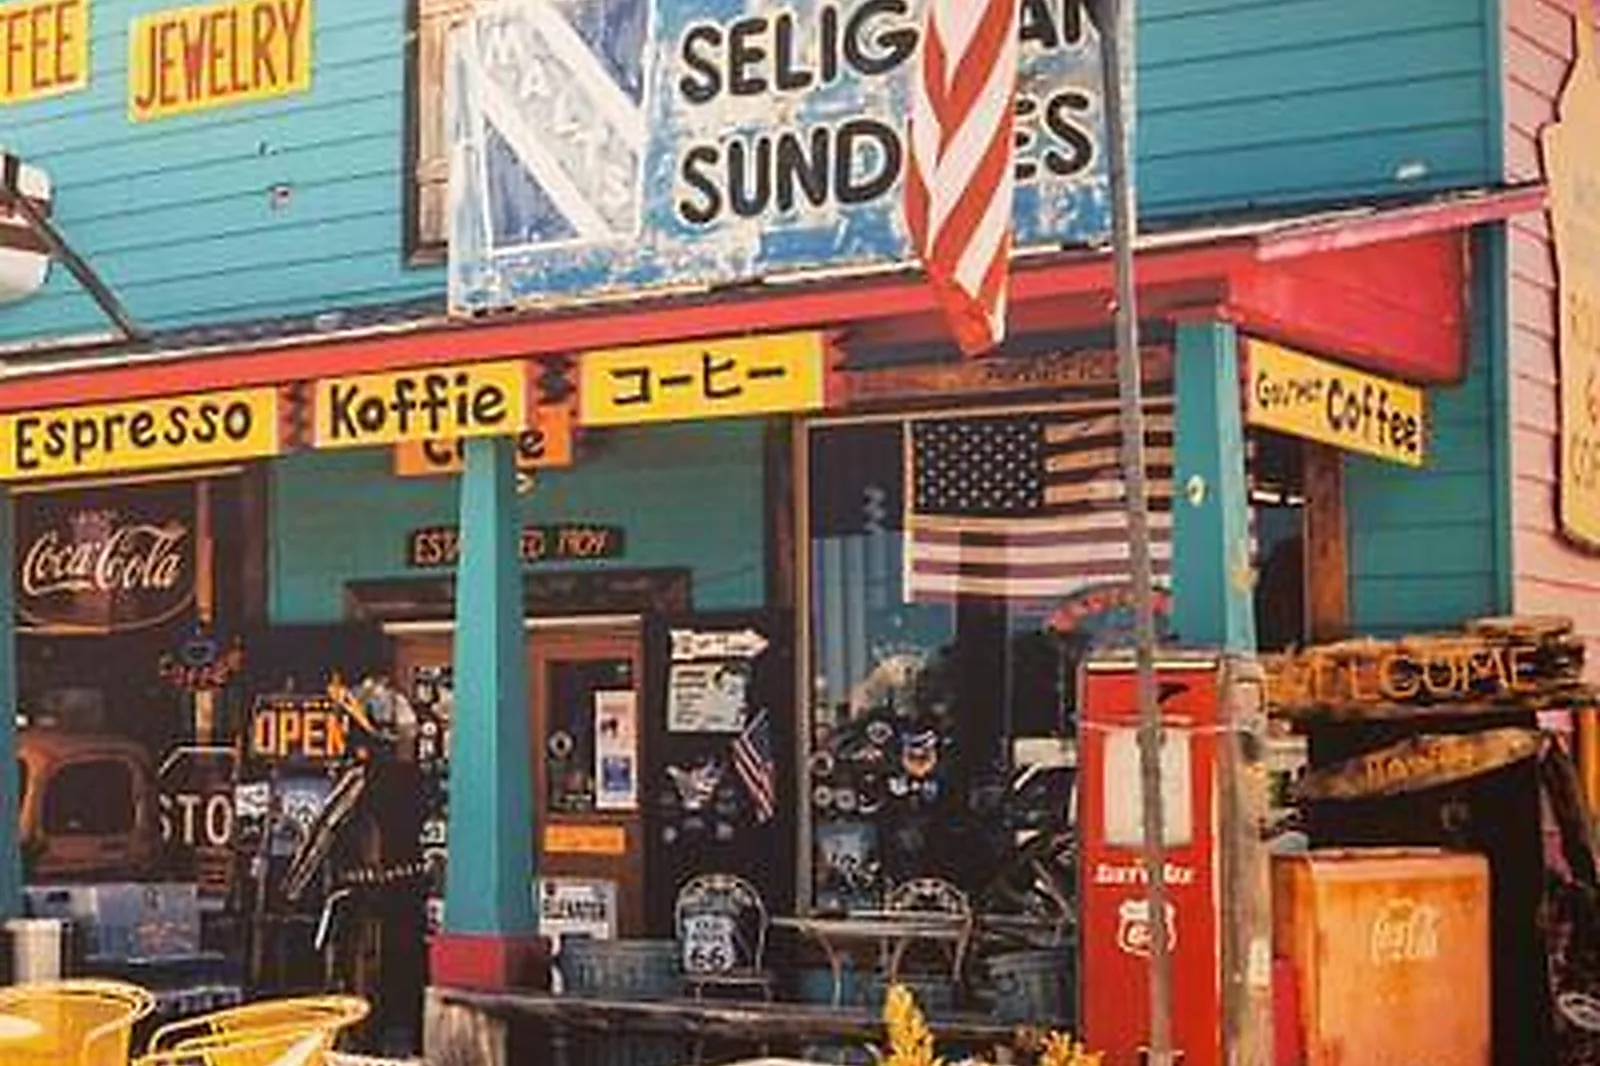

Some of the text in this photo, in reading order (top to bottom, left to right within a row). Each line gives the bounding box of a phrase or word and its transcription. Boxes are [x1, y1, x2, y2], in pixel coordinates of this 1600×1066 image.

[0, 0, 79, 94] FEE
[134, 0, 304, 108] JEWELRY
[680, 0, 1098, 103] SELIGAN
[680, 93, 1093, 224] SUNDES
[330, 372, 507, 438] Koffie
[611, 352, 785, 406] コーヒー
[15, 401, 251, 469] Espresso
[1326, 379, 1417, 452] Coffee
[253, 711, 349, 756] OPEN
[159, 793, 234, 846] STO
